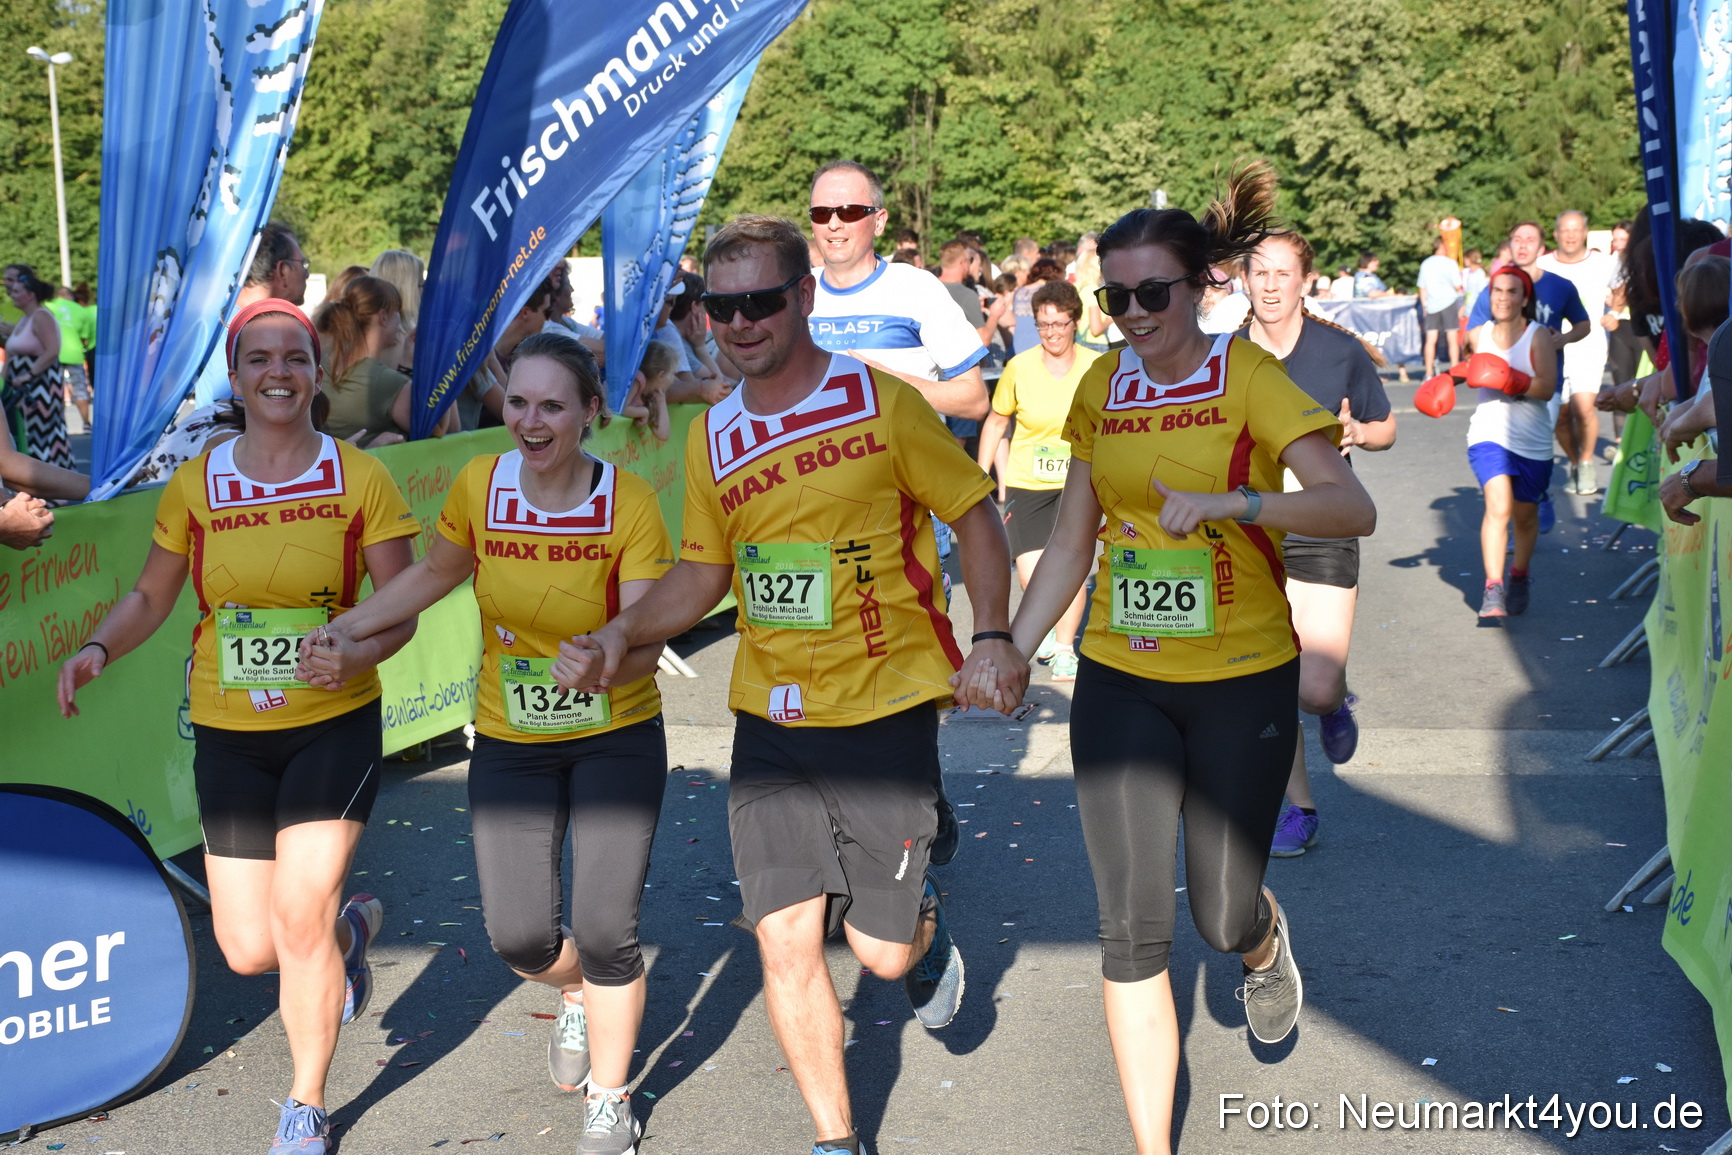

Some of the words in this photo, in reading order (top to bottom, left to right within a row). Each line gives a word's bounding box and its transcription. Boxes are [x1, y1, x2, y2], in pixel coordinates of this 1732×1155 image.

[622, 53, 687, 118] Druck
[687, 3, 730, 56] und
[427, 225, 548, 410] www.frischmann-net.de
[819, 320, 884, 336] PLAST
[1101, 416, 1155, 436] MAX
[1160, 406, 1228, 432] BÖGL
[719, 462, 787, 518] MAX
[793, 431, 888, 477] BÖGL
[210, 511, 271, 534] MAX
[279, 502, 348, 524] BÖGL
[484, 539, 540, 561] MAX
[547, 540, 613, 562] BÖGL
[21, 542, 100, 604] Firmen
[745, 572, 816, 605] 1327
[1118, 578, 1197, 612] 1326
[752, 603, 778, 613] Fröhlich
[779, 606, 809, 614] Michael
[1124, 610, 1155, 621] Schmidt
[1156, 613, 1188, 622] Carolin
[1129, 620, 1142, 629] Bögl
[1142, 621, 1174, 629] Bauservice
[241, 667, 270, 676] Vögele
[513, 684, 594, 713] 1324
[526, 712, 549, 721] Plank
[550, 711, 583, 721] Simone
[529, 719, 542, 727] Bögl
[542, 719, 574, 727] Bauservice
[575, 716, 594, 724] GmbH
[0, 996, 112, 1046] OBILE
